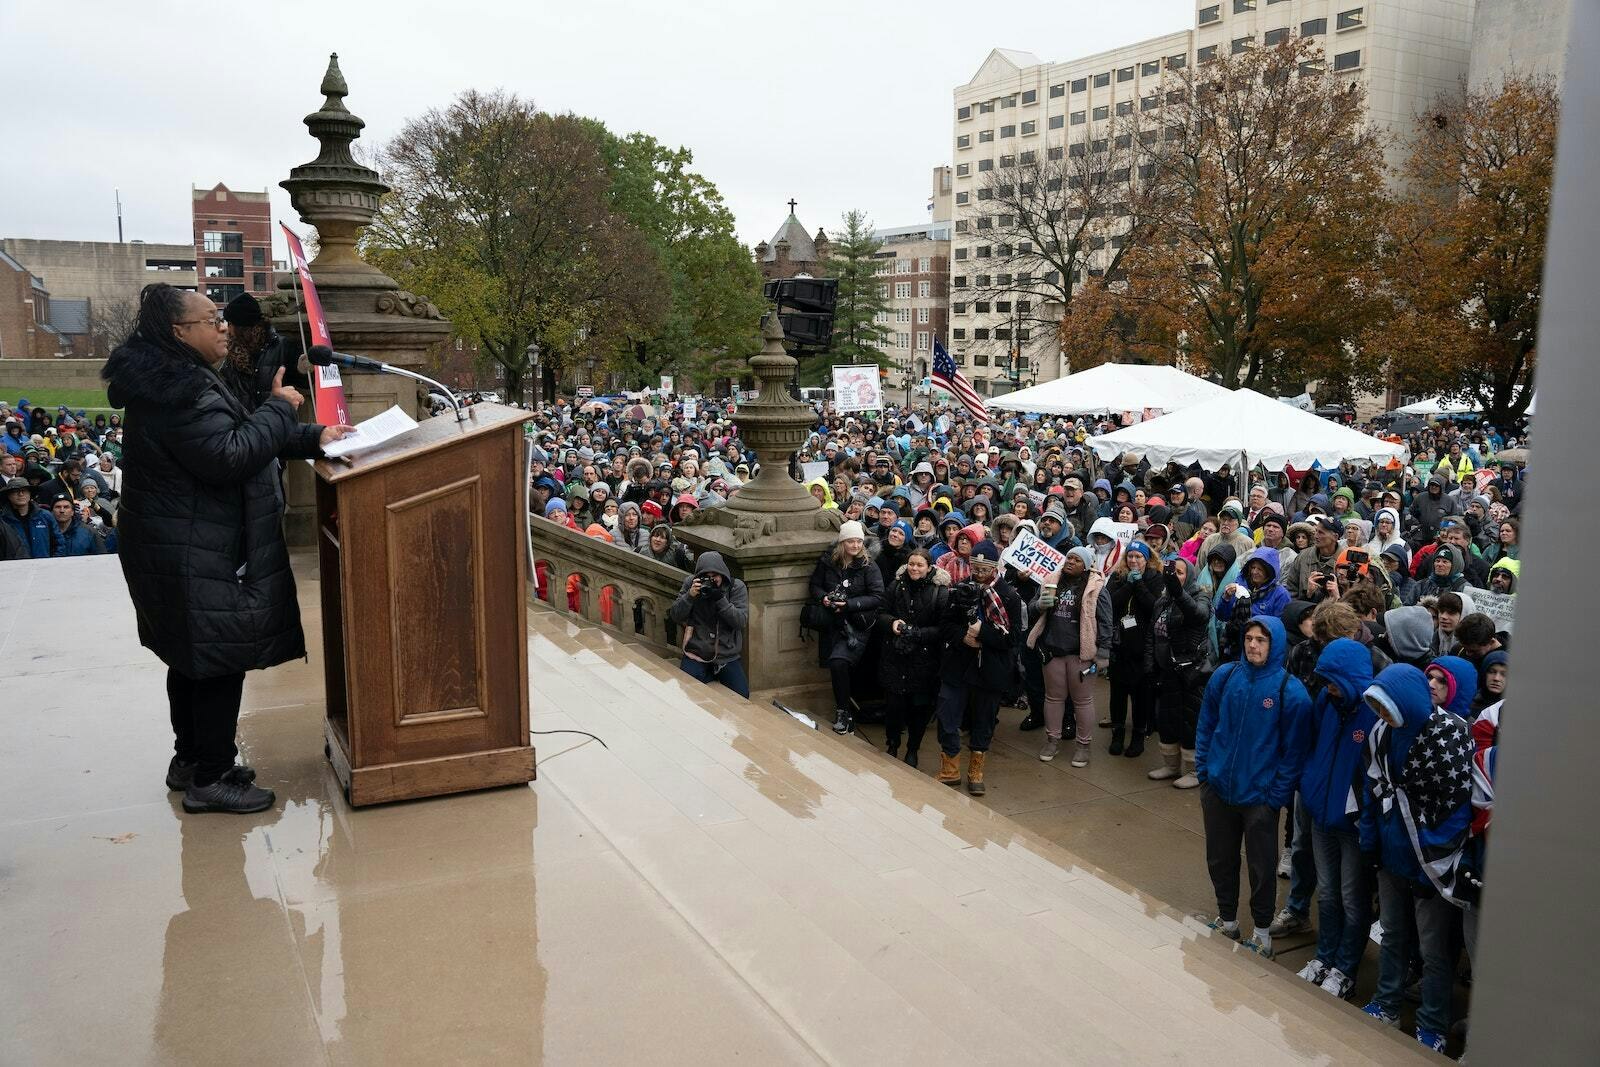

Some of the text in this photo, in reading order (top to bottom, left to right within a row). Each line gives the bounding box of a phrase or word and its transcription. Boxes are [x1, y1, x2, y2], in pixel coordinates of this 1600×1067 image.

[1011, 549, 1032, 567] FOR
[1019, 540, 1058, 572] VOTES
[1034, 540, 1063, 564] FAITH
